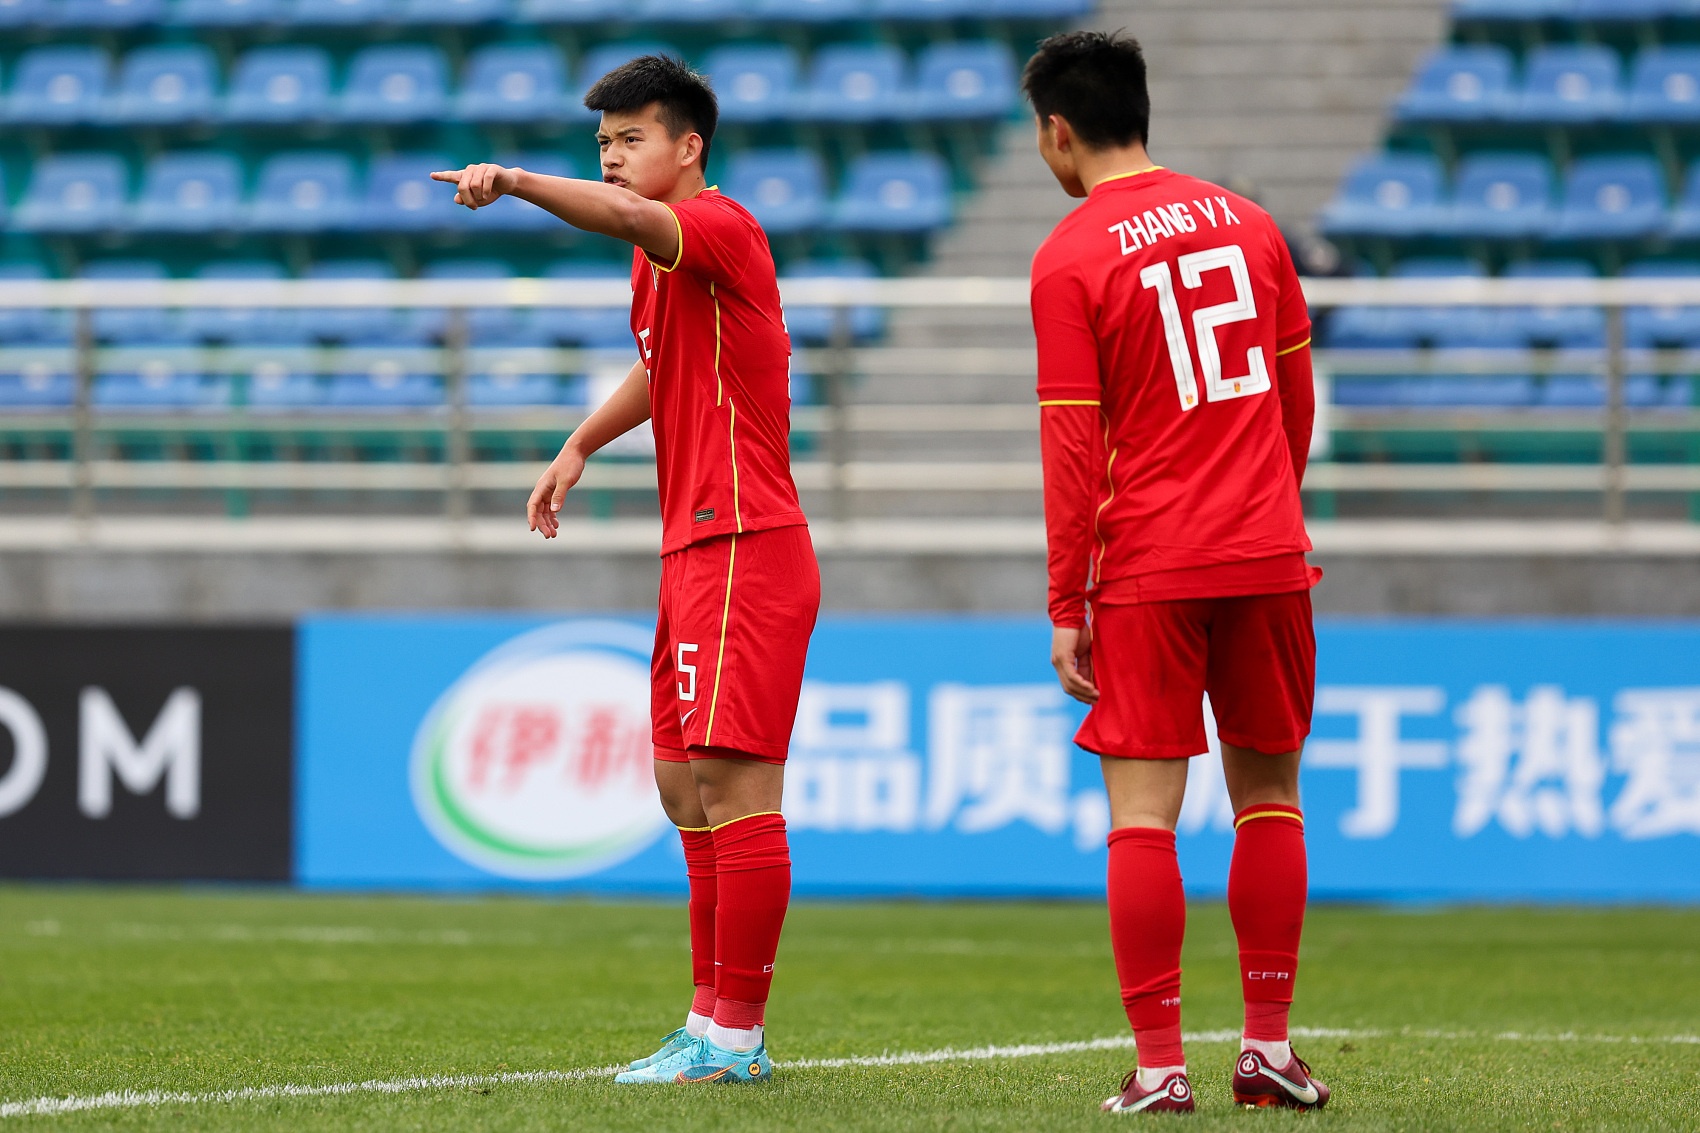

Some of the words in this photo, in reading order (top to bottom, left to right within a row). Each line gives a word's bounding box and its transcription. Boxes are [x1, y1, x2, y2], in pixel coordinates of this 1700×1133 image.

[1107, 202, 1197, 256] ZHANG
[1139, 244, 1271, 412] 12
[677, 642, 699, 702] 5
[1248, 971, 1289, 980] CFA
